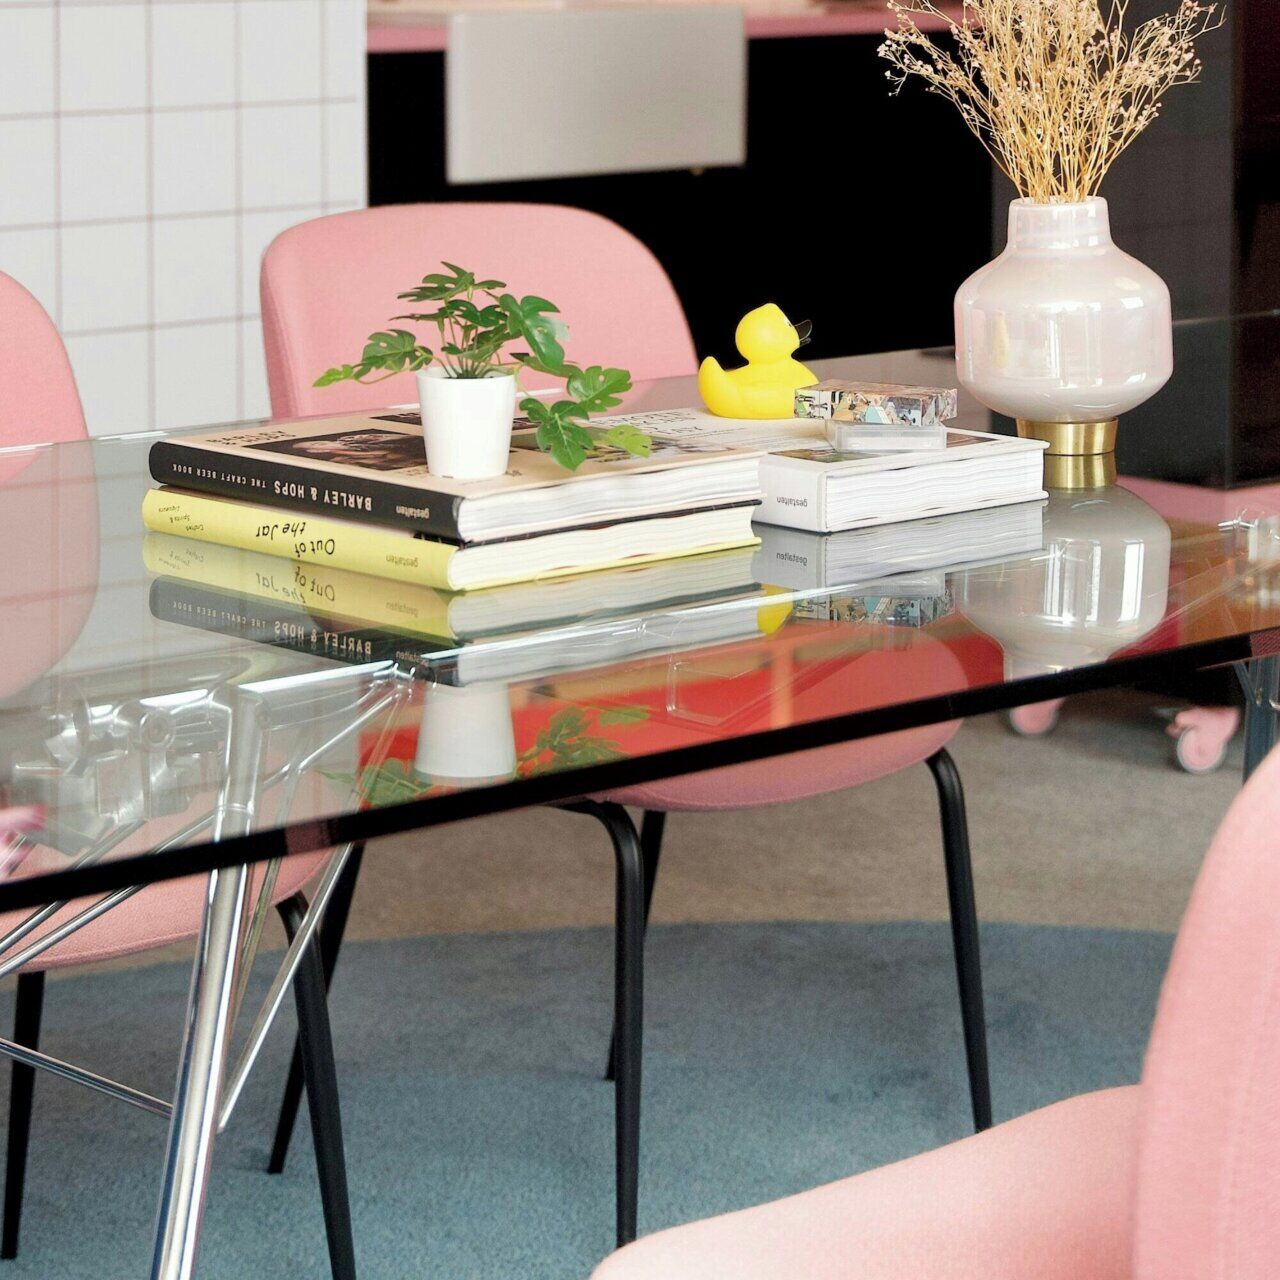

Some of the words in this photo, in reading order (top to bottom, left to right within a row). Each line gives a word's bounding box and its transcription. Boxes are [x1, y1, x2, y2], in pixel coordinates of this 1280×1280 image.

[173, 463, 194, 475] BOOK
[197, 468, 217, 480] BEER
[221, 472, 247, 486] CRAFT
[251, 478, 266, 489] THE
[274, 480, 305, 500] HOPS
[310, 486, 318, 501] &
[323, 491, 372, 512] BARLEY
[776, 496, 808, 508] gestalten
[395, 505, 430, 520] gestalten
[256, 525, 278, 540] Jar
[281, 522, 306, 535] the
[294, 542, 307, 558] of
[310, 538, 335, 555] Out
[386, 555, 419, 568] gestalten
